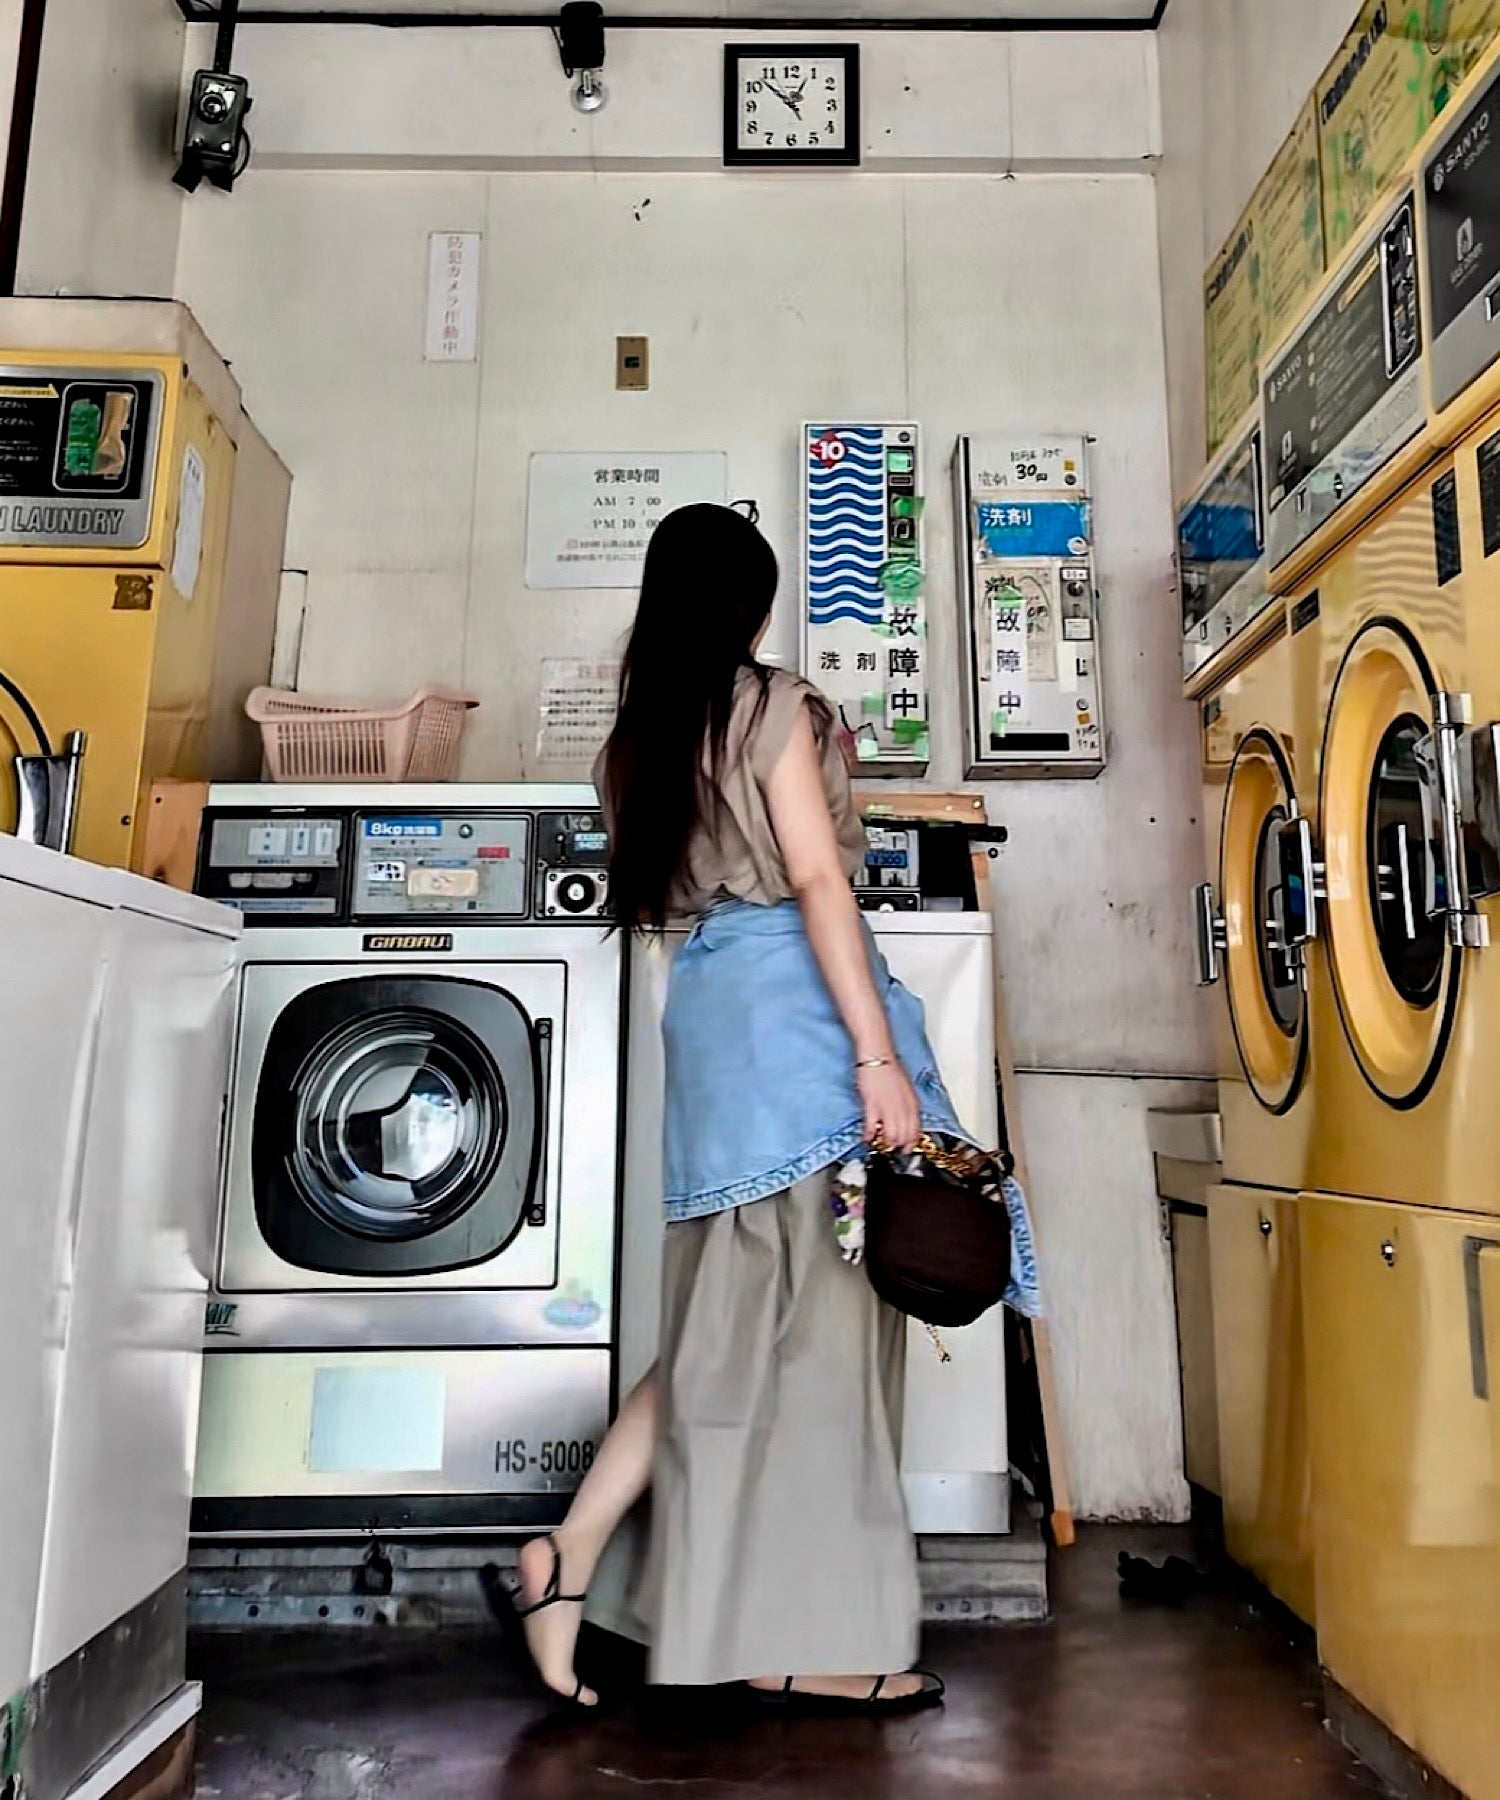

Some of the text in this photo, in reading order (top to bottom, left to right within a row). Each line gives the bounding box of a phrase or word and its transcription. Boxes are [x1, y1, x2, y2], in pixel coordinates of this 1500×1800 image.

[762, 67, 776, 80] 11
[783, 65, 800, 79] 12
[811, 67, 817, 80] 1
[746, 81, 763, 93] 10
[825, 77, 835, 91] 2
[746, 101, 757, 113] 9
[827, 99, 837, 112] 3
[747, 121, 758, 134] 8
[825, 121, 835, 134] 4
[765, 132, 774, 145] 7
[786, 134, 797, 146] 6
[809, 132, 819, 145] 5
[1446, 112, 1489, 173] SANYO
[820, 441, 846, 461] 10
[594, 468, 660, 483] 営業時間
[594, 496, 616, 506] AM
[646, 497, 661, 506] 00
[12, 505, 125, 535] LAUNDRY
[981, 507, 1032, 527] 洗剤
[594, 519, 616, 529] PM
[622, 519, 636, 530] 10
[820, 651, 876, 672] 洗剤
[889, 607, 920, 718] 故障中
[996, 606, 1022, 715] 故障中
[495, 1440, 594, 1473] HS-5008
